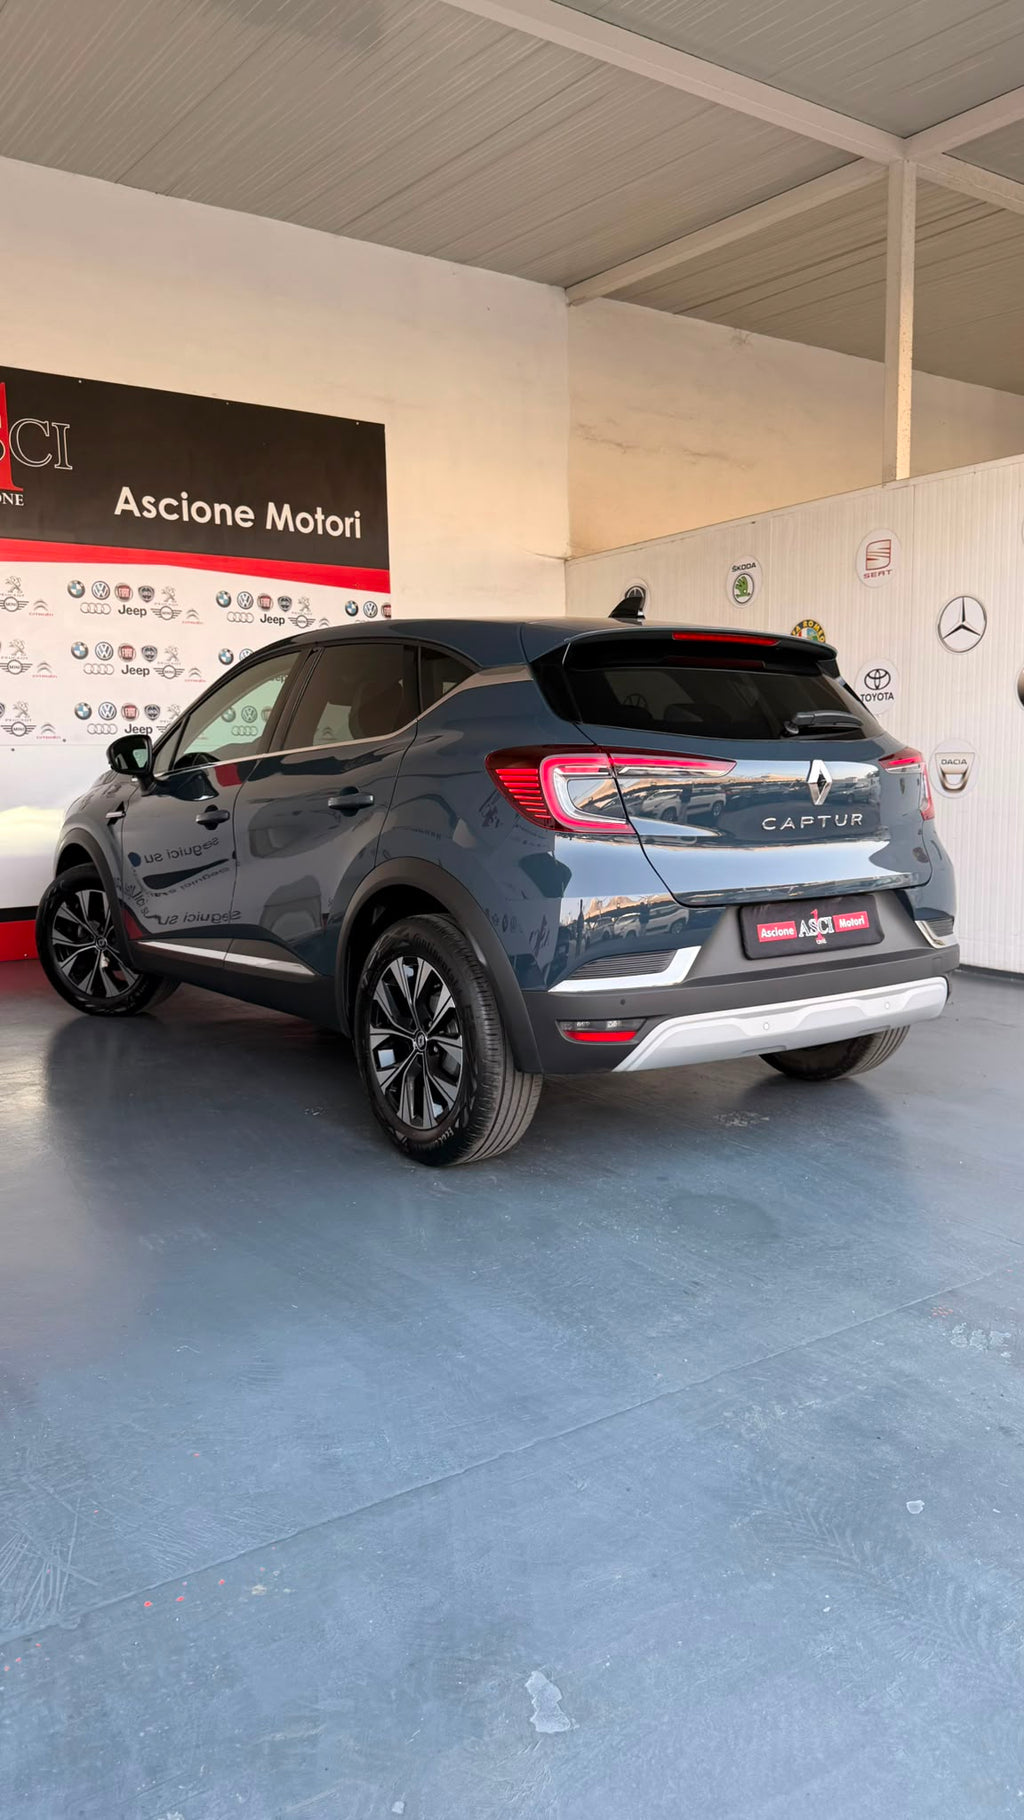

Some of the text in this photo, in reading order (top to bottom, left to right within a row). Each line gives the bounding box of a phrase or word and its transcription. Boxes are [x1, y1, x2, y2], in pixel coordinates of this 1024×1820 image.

[0, 492, 24, 506] NE
[114, 486, 361, 539] Ascione Motori
[731, 562, 757, 573] ŠKODA
[863, 569, 893, 580] SEAT
[118, 604, 147, 618] Jeep
[259, 613, 286, 626] Jeep
[121, 664, 150, 677] Jeep
[861, 692, 894, 702] TOYOTA
[124, 724, 153, 735] Jeep
[762, 814, 862, 831] CAPTUR
[761, 926, 795, 938] Ascione
[839, 916, 865, 928] Motori
